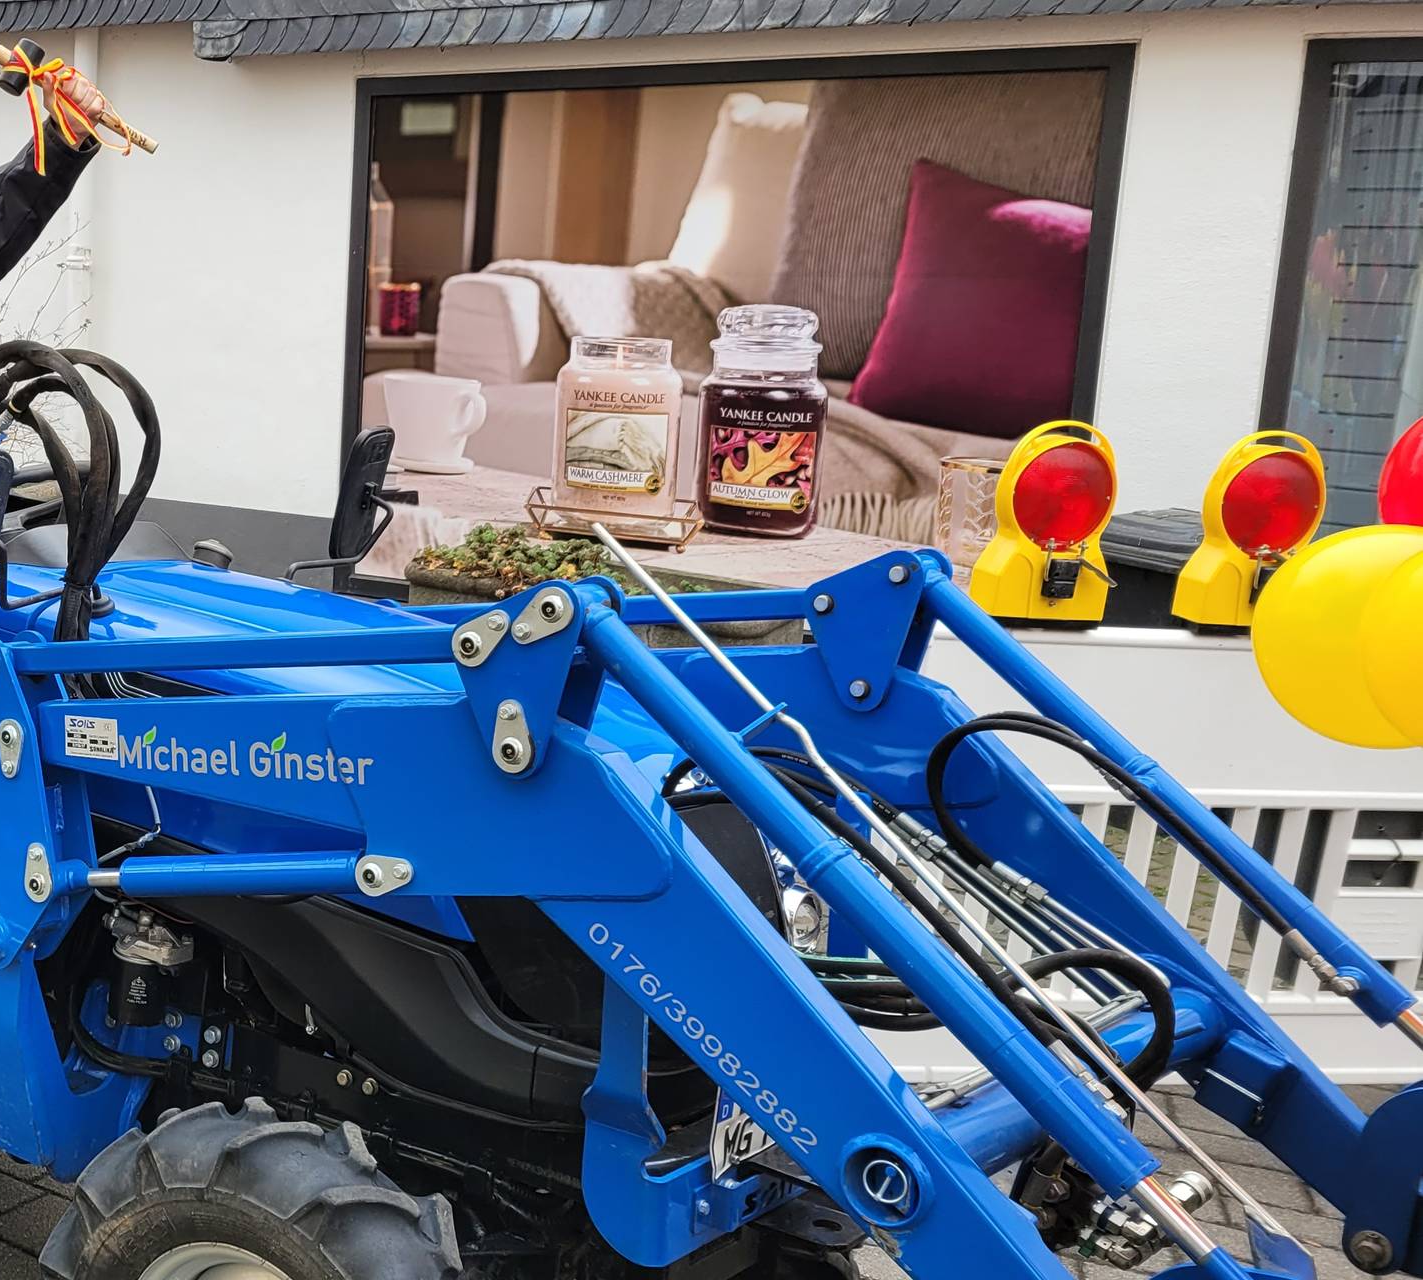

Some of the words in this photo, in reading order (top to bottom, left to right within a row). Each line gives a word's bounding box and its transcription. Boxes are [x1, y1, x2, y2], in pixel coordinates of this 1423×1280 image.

[574, 389, 617, 403] YANKEE
[620, 392, 666, 405] CANDLE
[719, 406, 764, 422] YANKEE
[766, 410, 814, 424] CANDLE
[570, 467, 594, 482] WARM
[596, 470, 644, 484] CASHMERE
[712, 484, 757, 498] AUTUMN
[758, 488, 790, 499] GLOW
[118, 726, 240, 777] Michael
[248, 732, 374, 785] Ginster
[588, 922, 819, 1155] 0176/39982882
[721, 1104, 729, 1120] D
